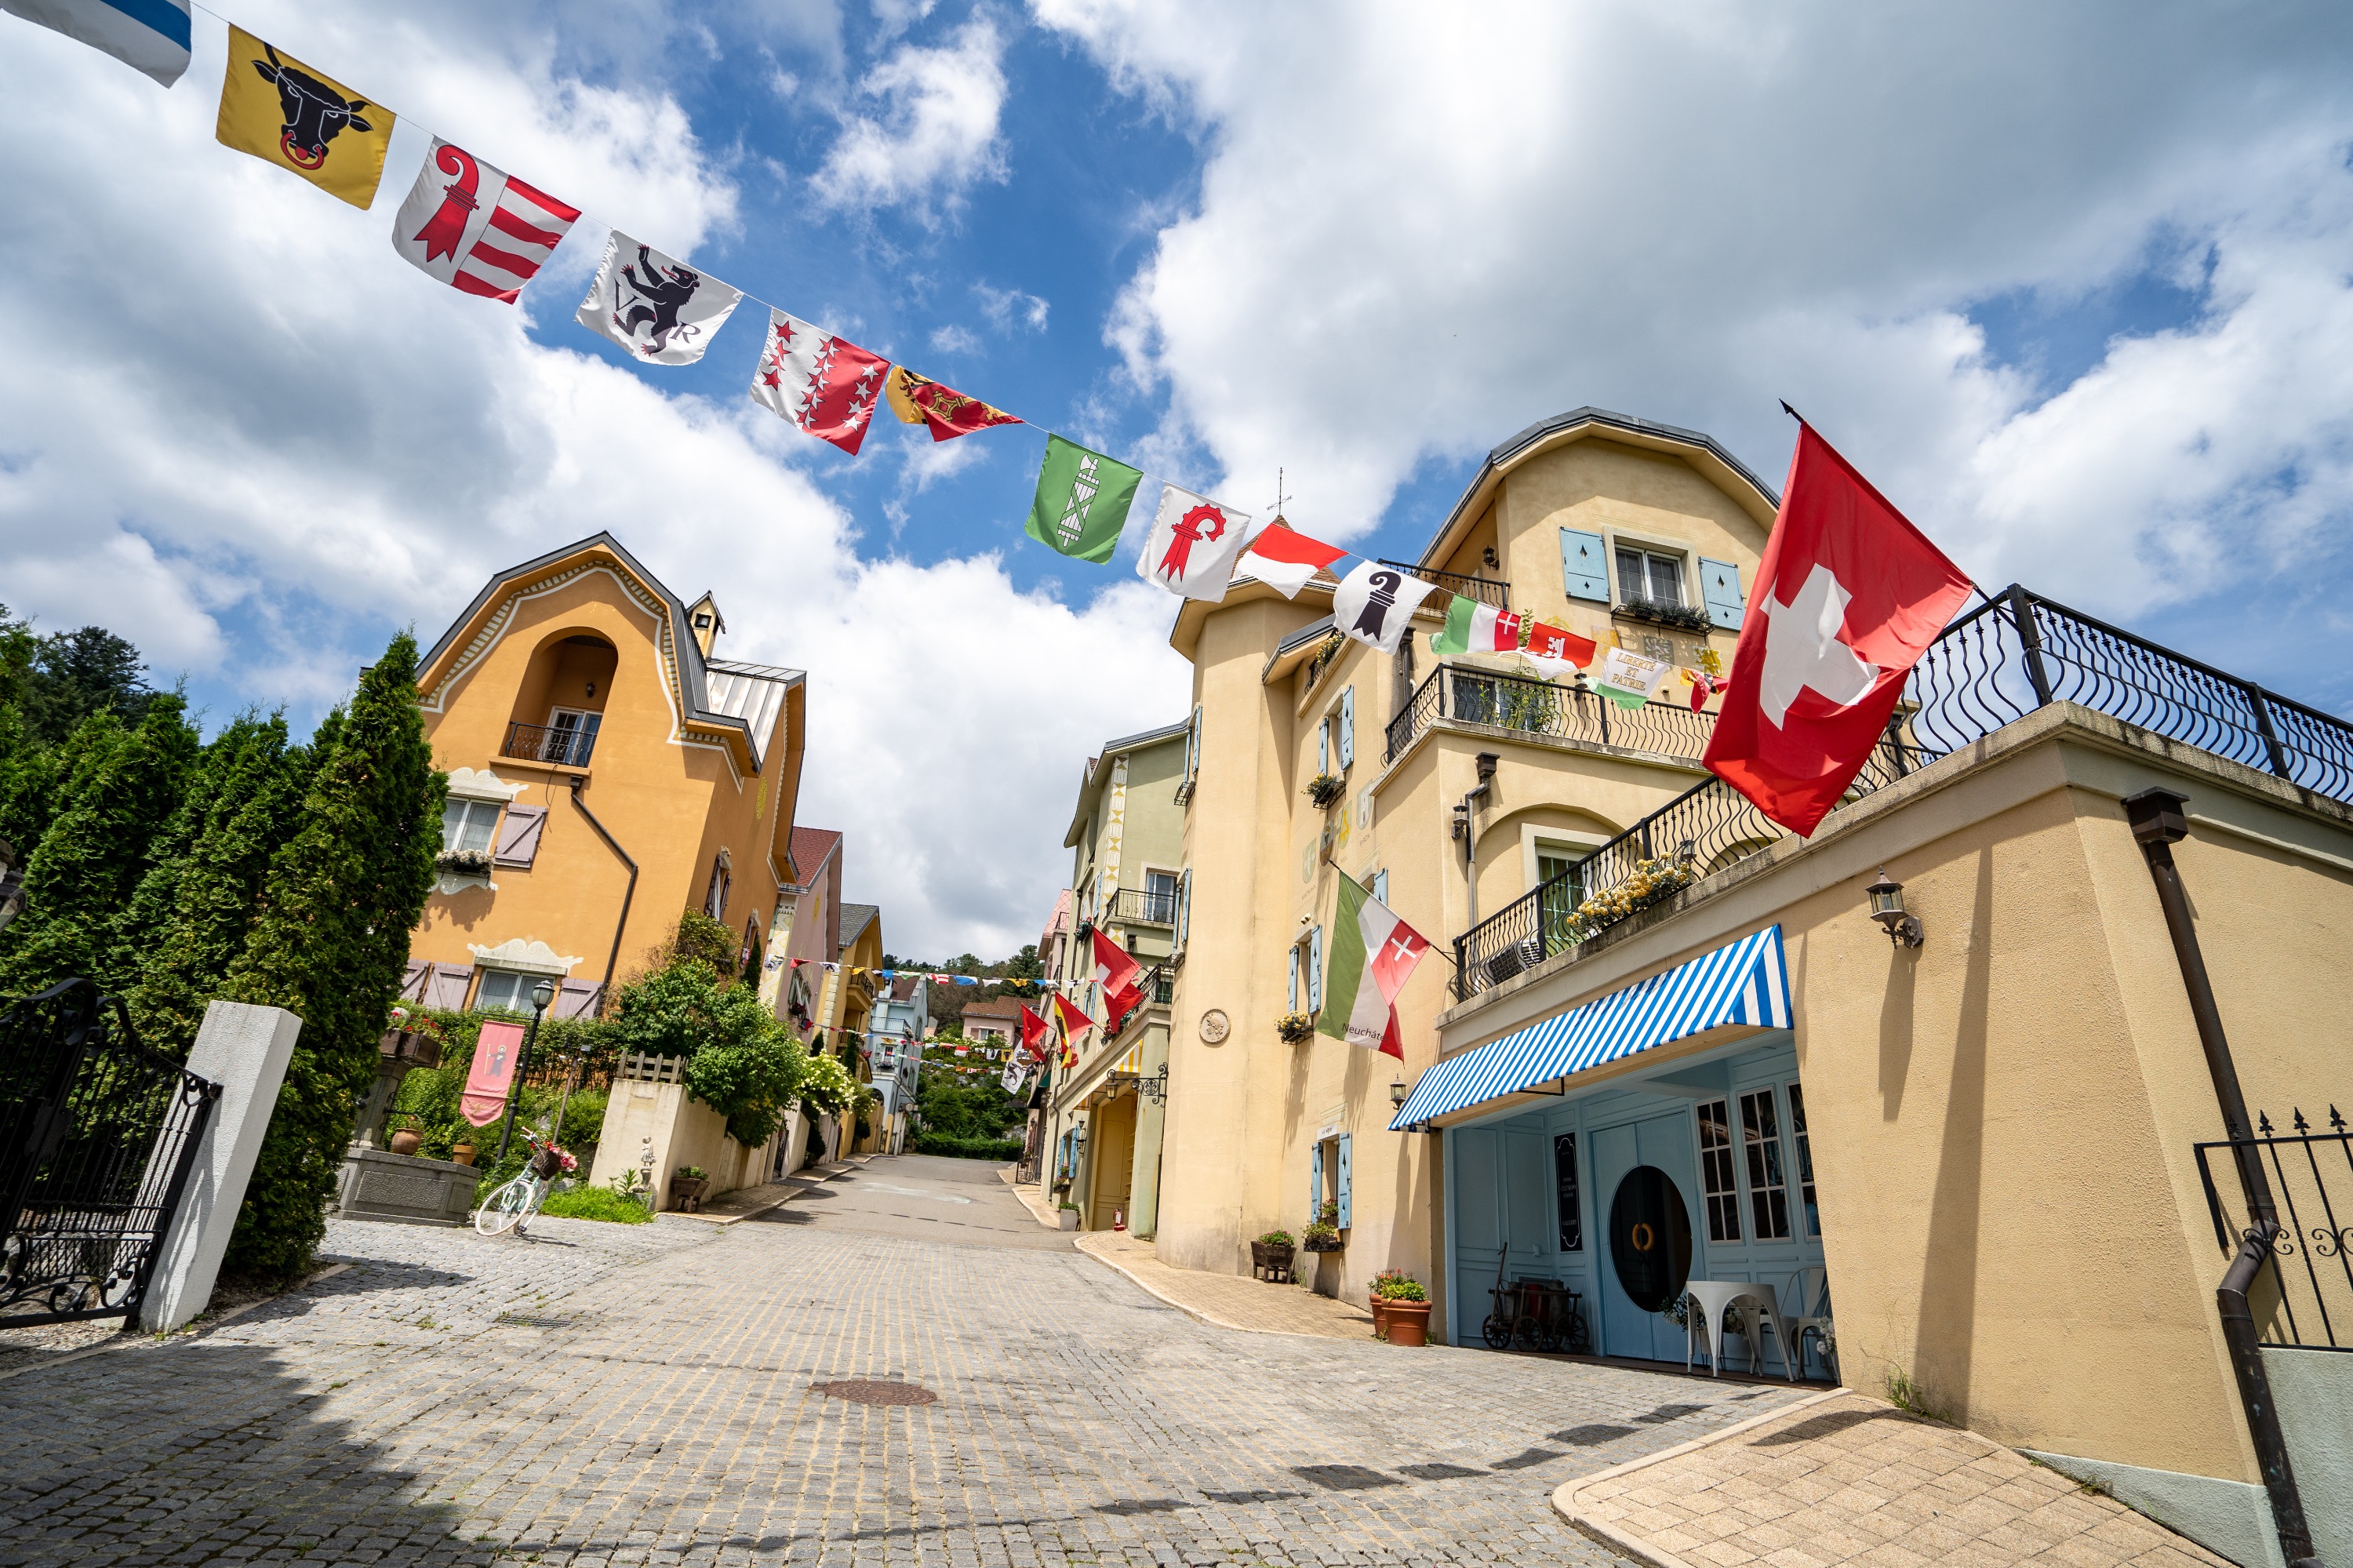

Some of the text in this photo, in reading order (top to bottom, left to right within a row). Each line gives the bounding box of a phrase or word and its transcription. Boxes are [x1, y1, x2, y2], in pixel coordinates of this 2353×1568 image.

[613, 276, 642, 311] V
[668, 320, 700, 344] R
[1616, 652, 1657, 671] LIBERTÉ
[1624, 666, 1639, 678] ET
[1611, 673, 1646, 691] PATRIE
[1342, 1022, 1389, 1042] Neuchâtel
